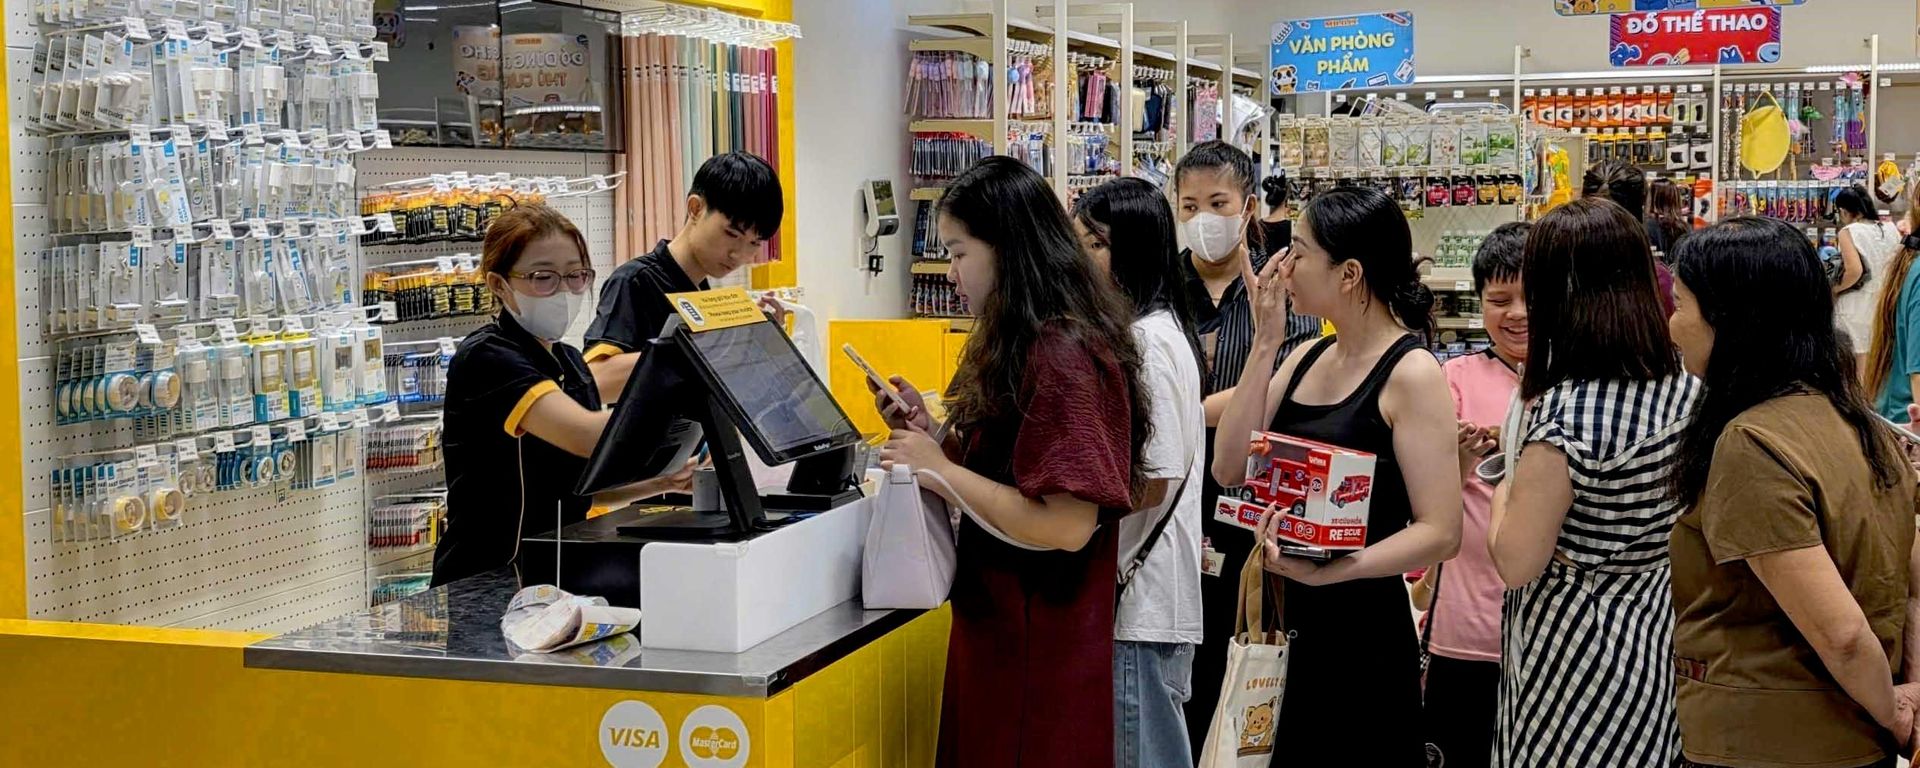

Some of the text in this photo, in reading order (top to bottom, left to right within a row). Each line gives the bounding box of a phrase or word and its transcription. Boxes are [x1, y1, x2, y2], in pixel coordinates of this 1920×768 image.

[1706, 13, 1768, 31] THAO
[1289, 30, 1395, 54] VĂN PHÒNG
[1316, 51, 1369, 74] PHẨM
[608, 727, 660, 748] VISA
[692, 737, 737, 749] MasterCard
